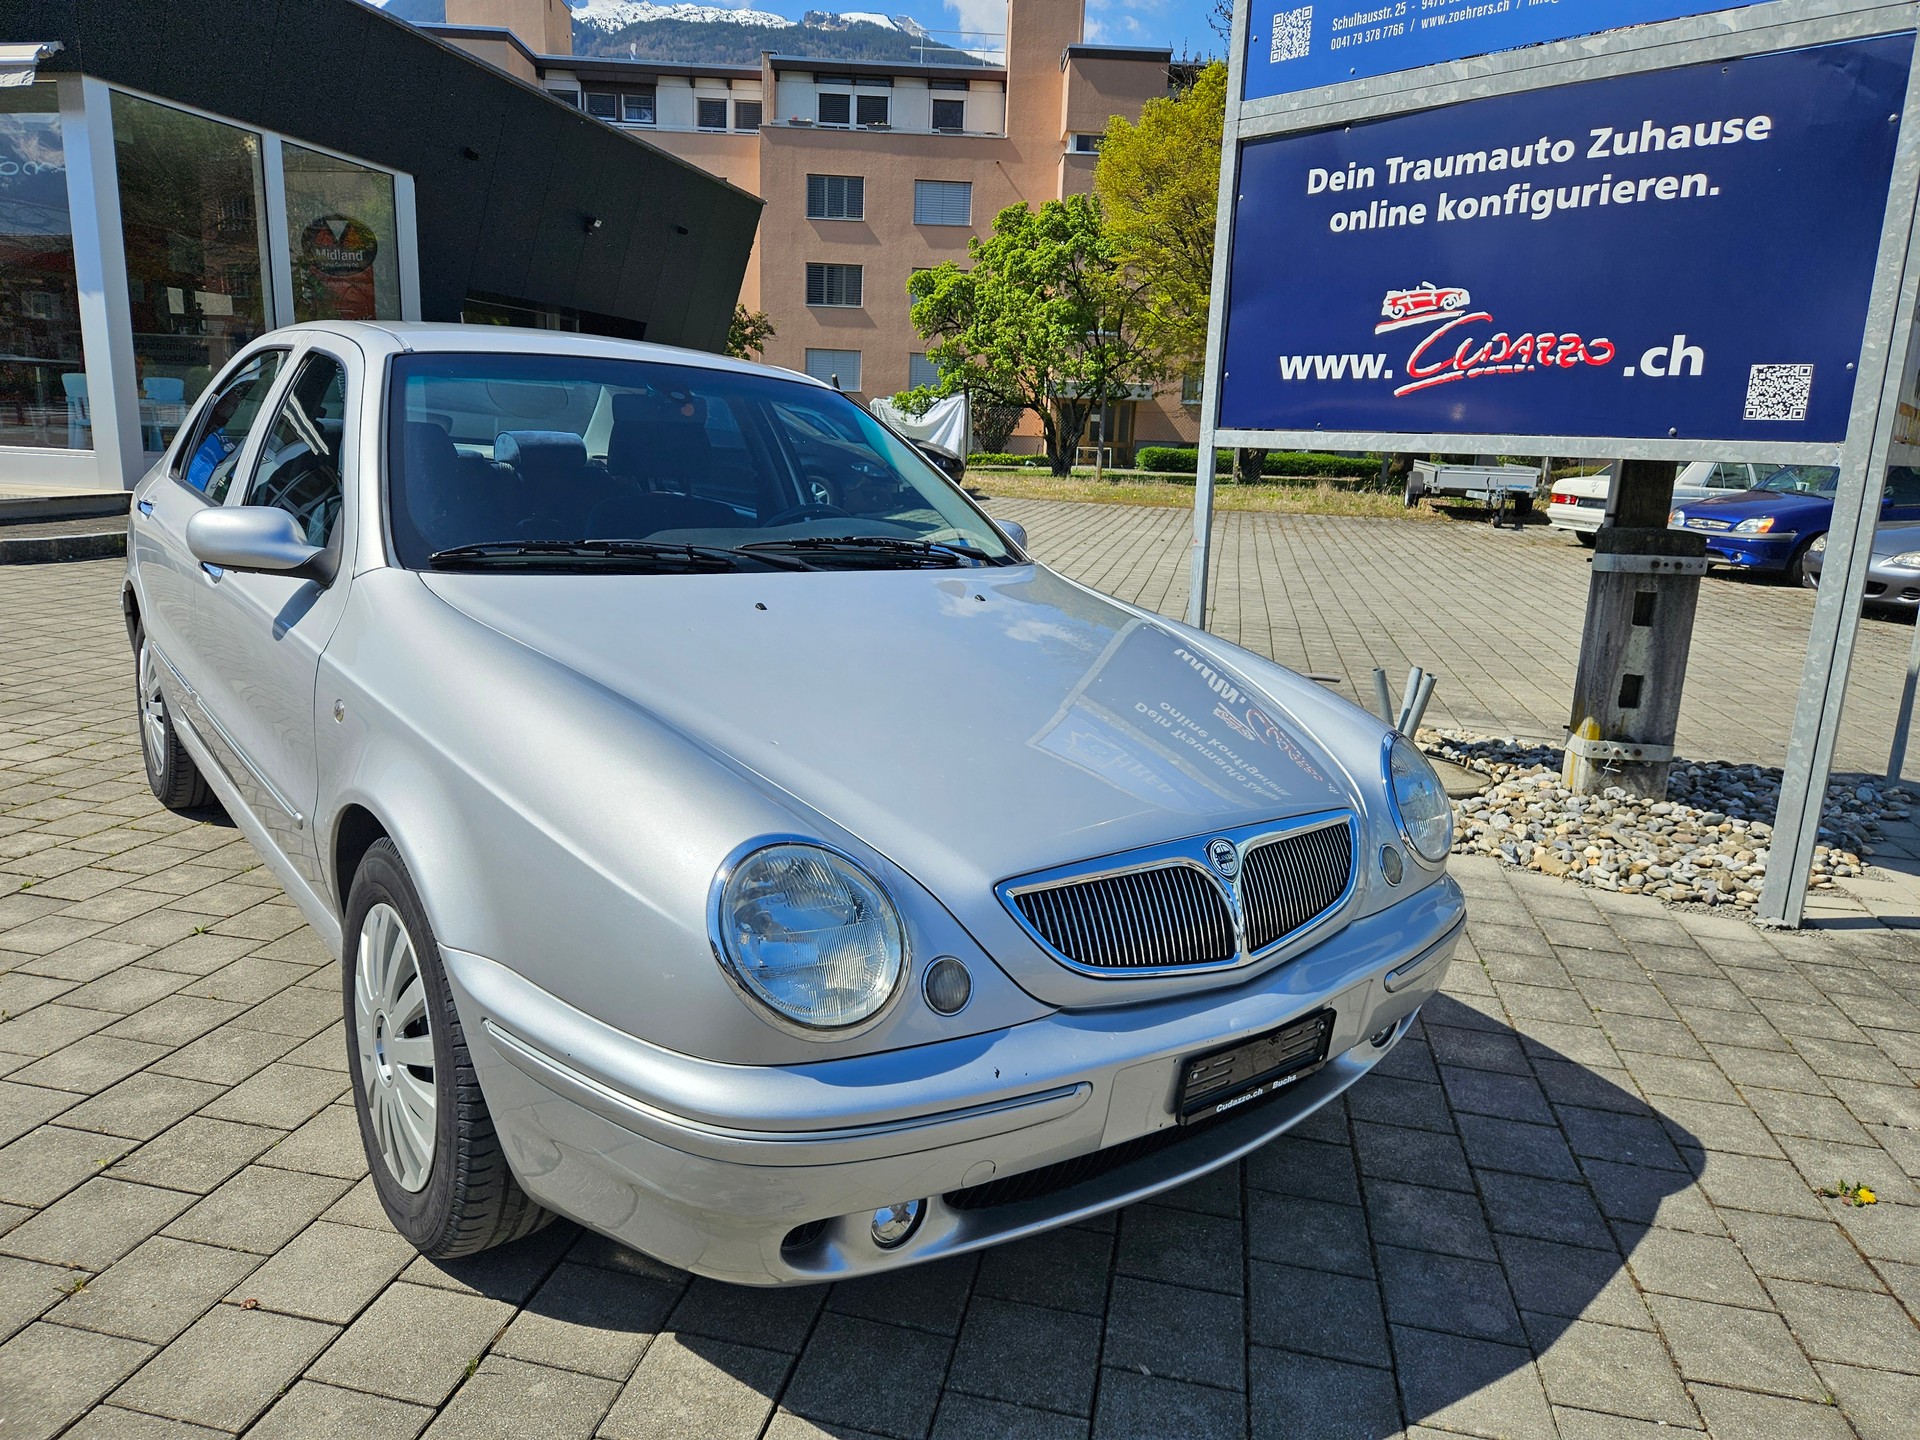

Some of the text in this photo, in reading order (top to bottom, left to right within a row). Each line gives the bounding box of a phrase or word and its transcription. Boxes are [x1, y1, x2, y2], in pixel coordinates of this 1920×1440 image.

[1330, 35, 1351, 50] 0041
[1352, 32, 1364, 46] 79
[1365, 28, 1381, 42] 378
[1383, 22, 1404, 40] 7766
[1421, 0, 1510, 30] www.zoehrers.ch
[1332, 8, 1393, 31] Schulhausstr.
[1394, 2, 1407, 17] 25
[1306, 114, 1772, 196] Dein Traumauto Zuhause
[1329, 171, 1721, 233] online konfigurieren.
[1279, 352, 1394, 381] www.
[1622, 333, 1705, 378] .ch
[1215, 1073, 1297, 1113] Cudazzo.ch Buchs
